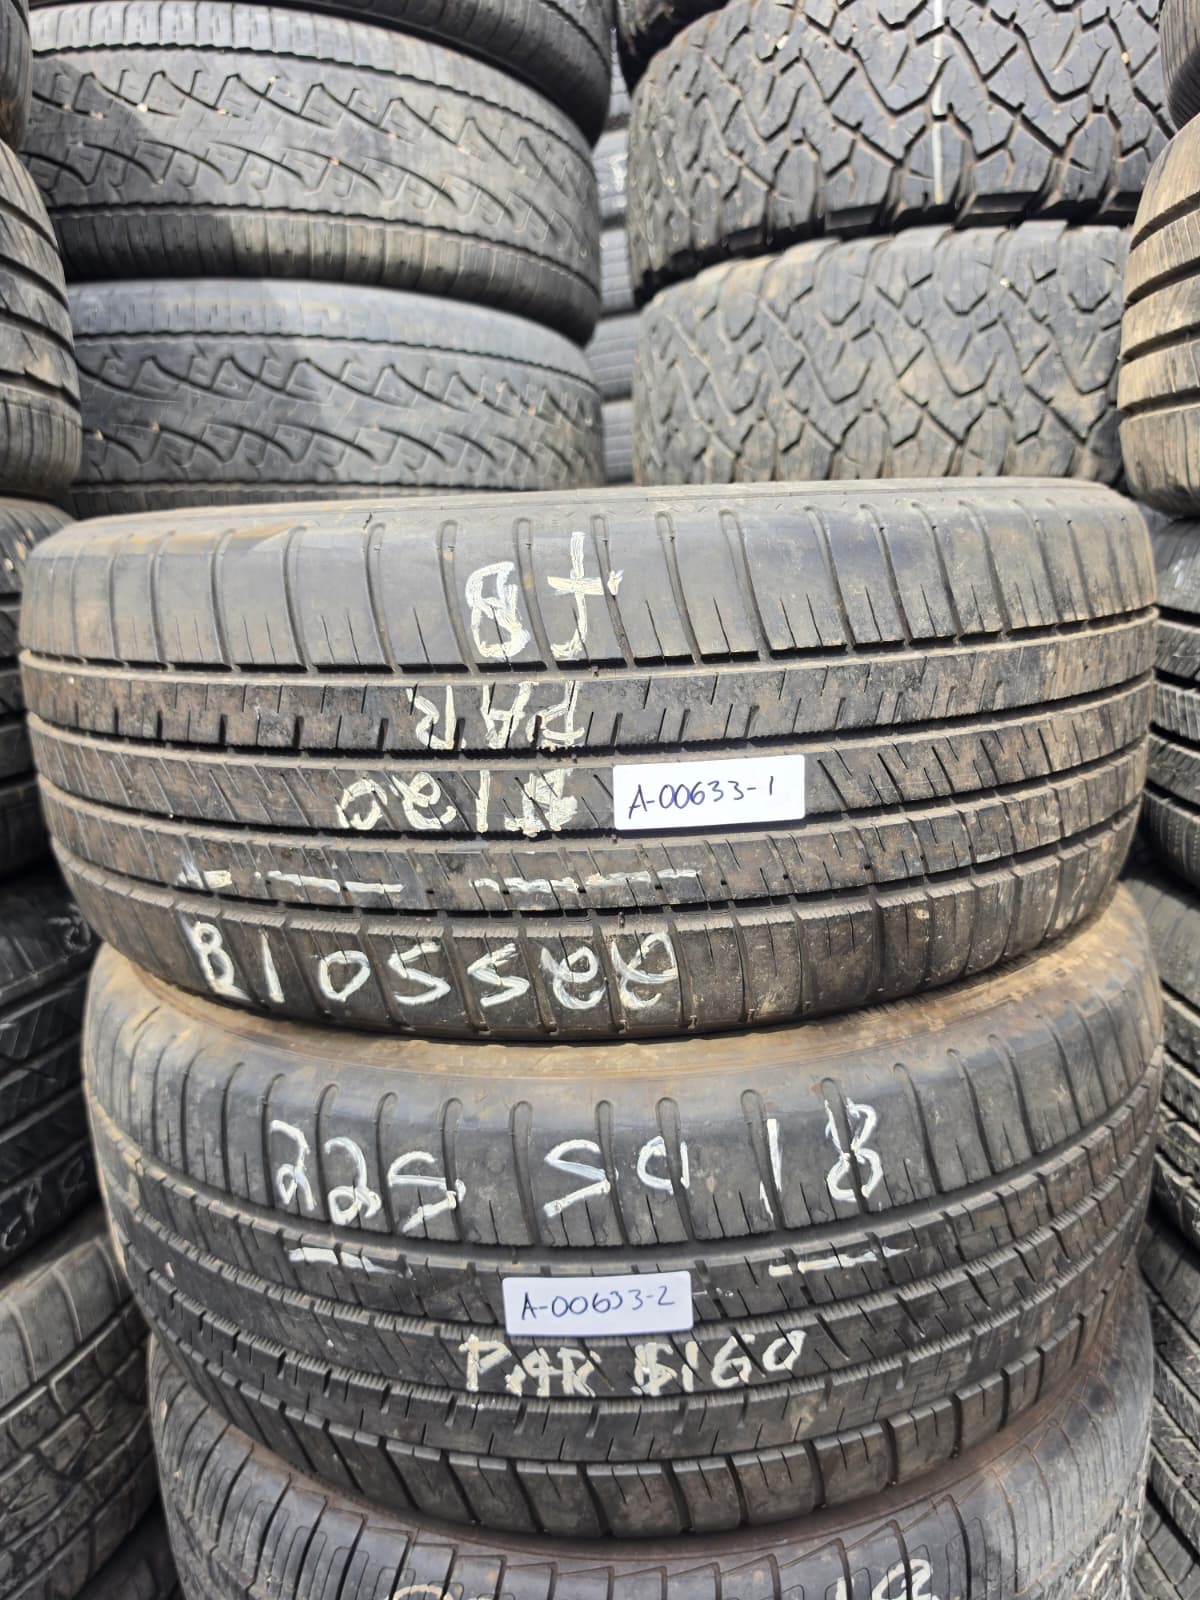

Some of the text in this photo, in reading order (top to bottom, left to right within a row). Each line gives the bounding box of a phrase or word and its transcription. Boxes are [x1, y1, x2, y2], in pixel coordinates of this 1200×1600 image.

[406, 680, 586, 752] PAR
[268, 1099, 886, 1233] 225 50 18
[459, 1334, 602, 1397] PAR
